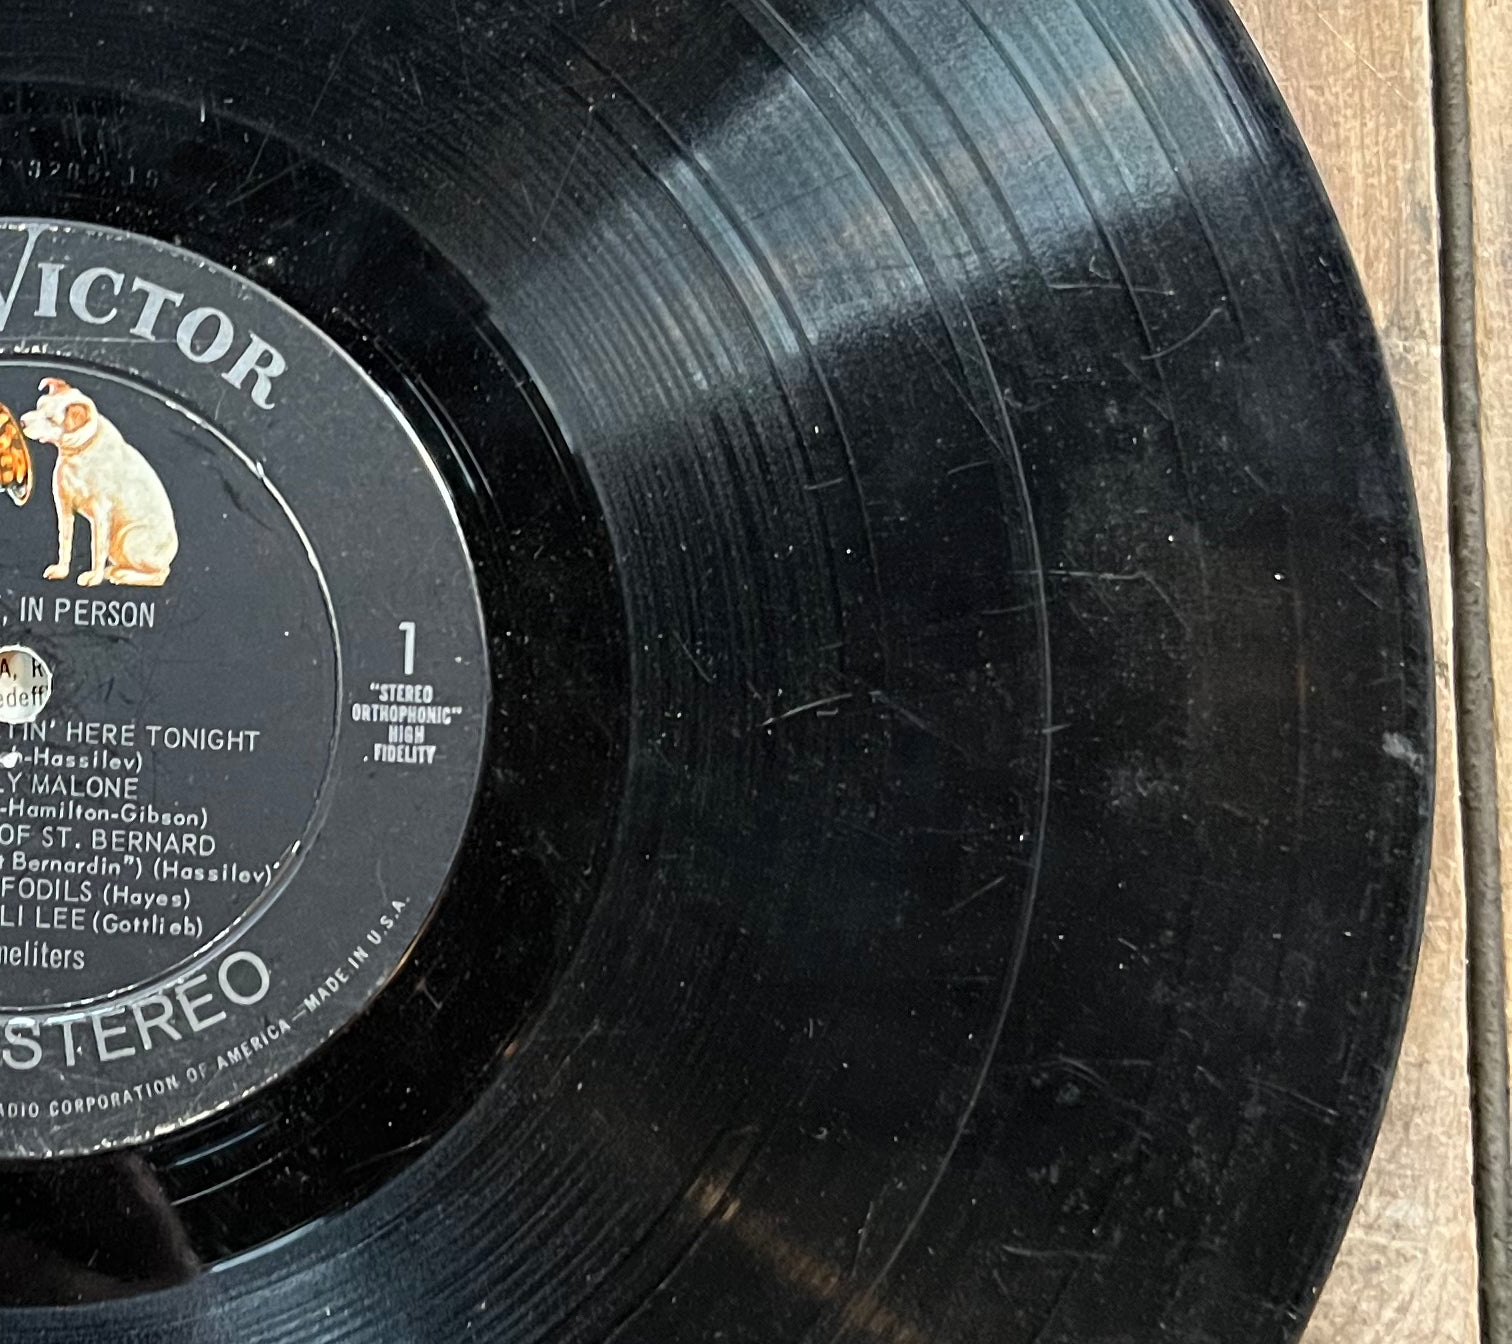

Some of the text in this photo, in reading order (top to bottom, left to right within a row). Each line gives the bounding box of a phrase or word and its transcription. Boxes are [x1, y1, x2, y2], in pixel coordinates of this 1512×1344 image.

[20, 599, 44, 622] IN
[55, 600, 155, 628] PERSON
[399, 621, 415, 675] 1
[67, 723, 135, 746] HERE
[146, 725, 260, 752] TONIGHT
[388, 725, 425, 744] HIGH
[374, 743, 436, 764] FIDELITY
[31, 773, 139, 799] MALONE
[42, 827, 81, 850] ST.
[91, 829, 216, 857] BERNARD
[153, 858, 273, 887] (Hassilev)
[103, 881, 191, 910] (Hayes)
[0, 906, 24, 927] LI
[35, 907, 86, 931] LEE
[92, 910, 203, 938] (Gottlieb)
[2, 951, 270, 1070] STEREO
[49, 1075, 179, 1117] CORPORATION
[186, 1061, 208, 1083] OF
[348, 945, 370, 971] IN
